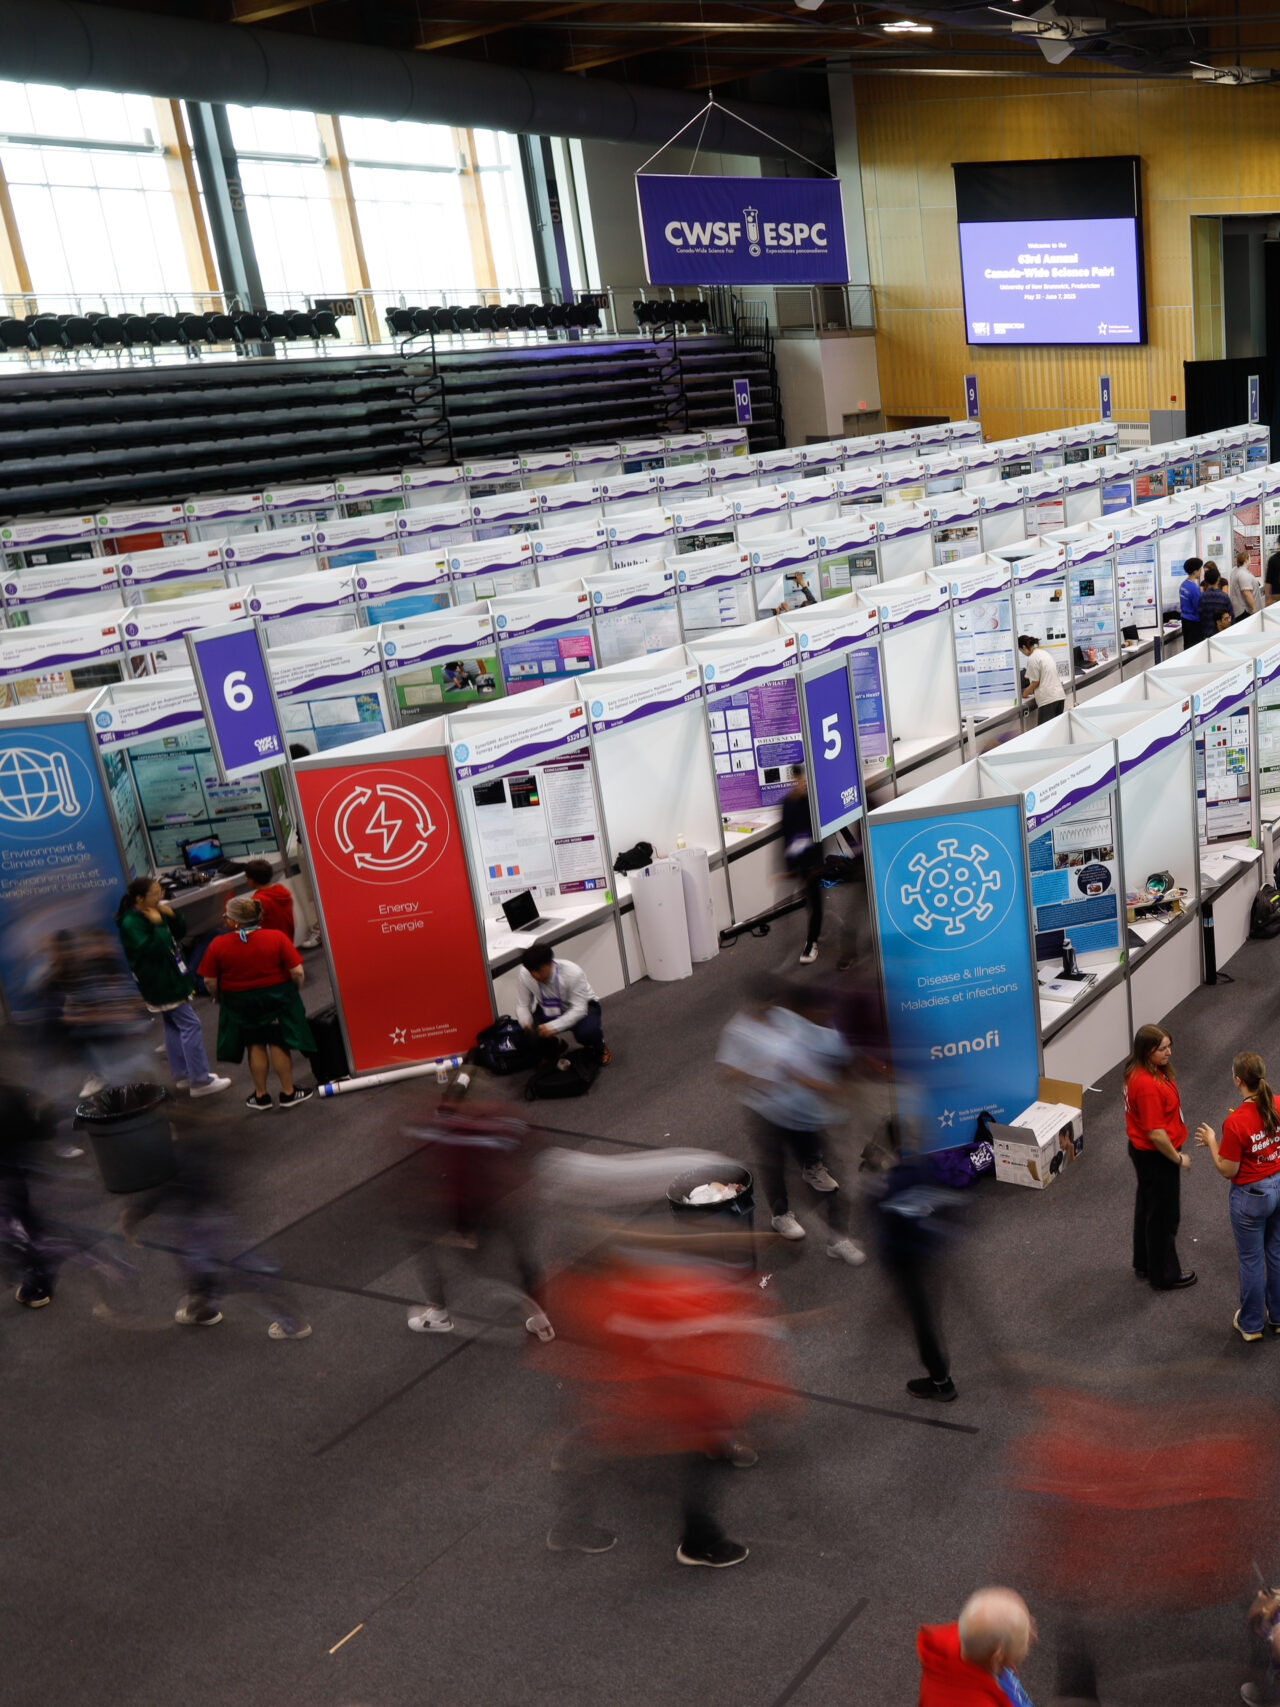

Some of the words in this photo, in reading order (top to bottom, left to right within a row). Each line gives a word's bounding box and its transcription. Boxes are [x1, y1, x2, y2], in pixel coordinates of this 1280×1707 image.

[664, 221, 741, 246] CWSF
[763, 222, 828, 246] ESPC
[1043, 253, 1078, 264] Annual
[984, 267, 1050, 279] Canada-Wide
[1051, 267, 1089, 278] Science
[736, 393, 748, 406] 10
[969, 388, 975, 401] 9
[1103, 389, 1108, 402] 8
[1252, 390, 1256, 404] 7
[223, 670, 254, 712] 6
[566, 733, 580, 743] 5329
[822, 713, 842, 760] 5
[1, 842, 74, 860] Environment
[76, 841, 86, 851] &
[1, 857, 45, 870] Climate
[46, 852, 92, 866] Change
[88, 868, 100, 878] et
[379, 901, 419, 915] Energy
[381, 919, 425, 934] Énergie
[917, 972, 960, 987] Disease
[963, 968, 972, 979] &
[974, 964, 1006, 977] Illness
[901, 995, 949, 1011] Maladies
[952, 992, 963, 1002] et
[966, 982, 1018, 1000] infections
[930, 1030, 1000, 1060] sanofi
